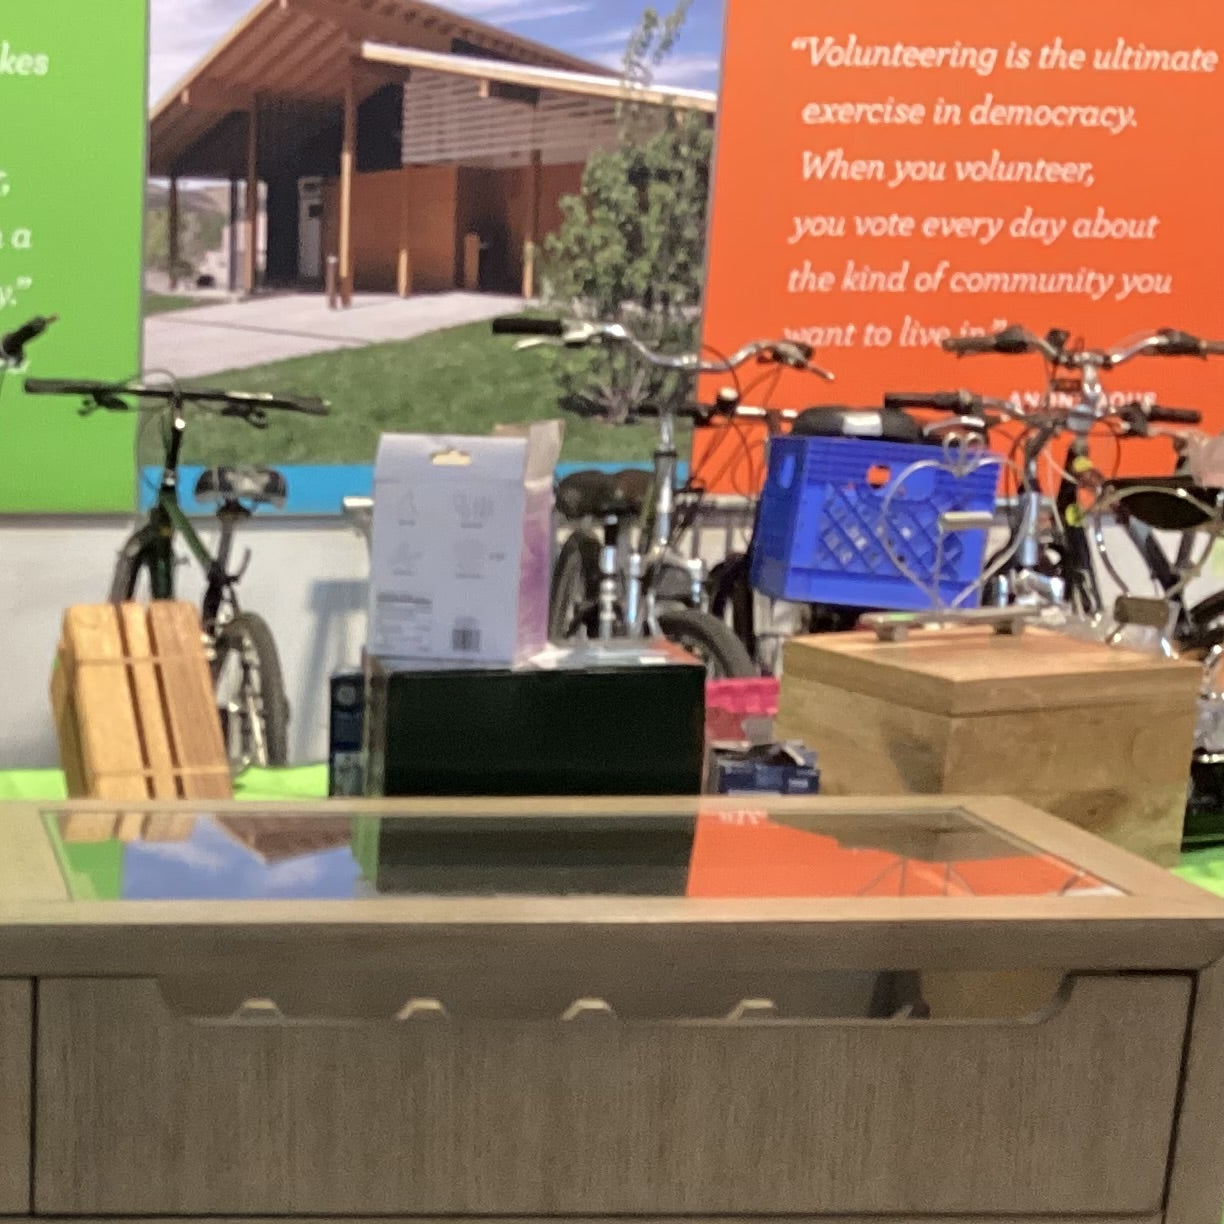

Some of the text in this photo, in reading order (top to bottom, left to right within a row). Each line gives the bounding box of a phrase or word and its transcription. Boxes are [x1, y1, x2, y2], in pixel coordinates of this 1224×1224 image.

[1005, 42, 1032, 69] is
[1038, 36, 1087, 70] the
[1093, 38, 1219, 72] ultimate
[801, 93, 1138, 134] exercise in democracy.
[802, 148, 1095, 188] When you volunteer,
[11, 229, 32, 250] a
[787, 206, 1160, 245] you vote every day about
[787, 259, 1173, 301] the kind of community you
[784, 321, 857, 347] want
[863, 322, 893, 347] to
[899, 315, 951, 347] live
